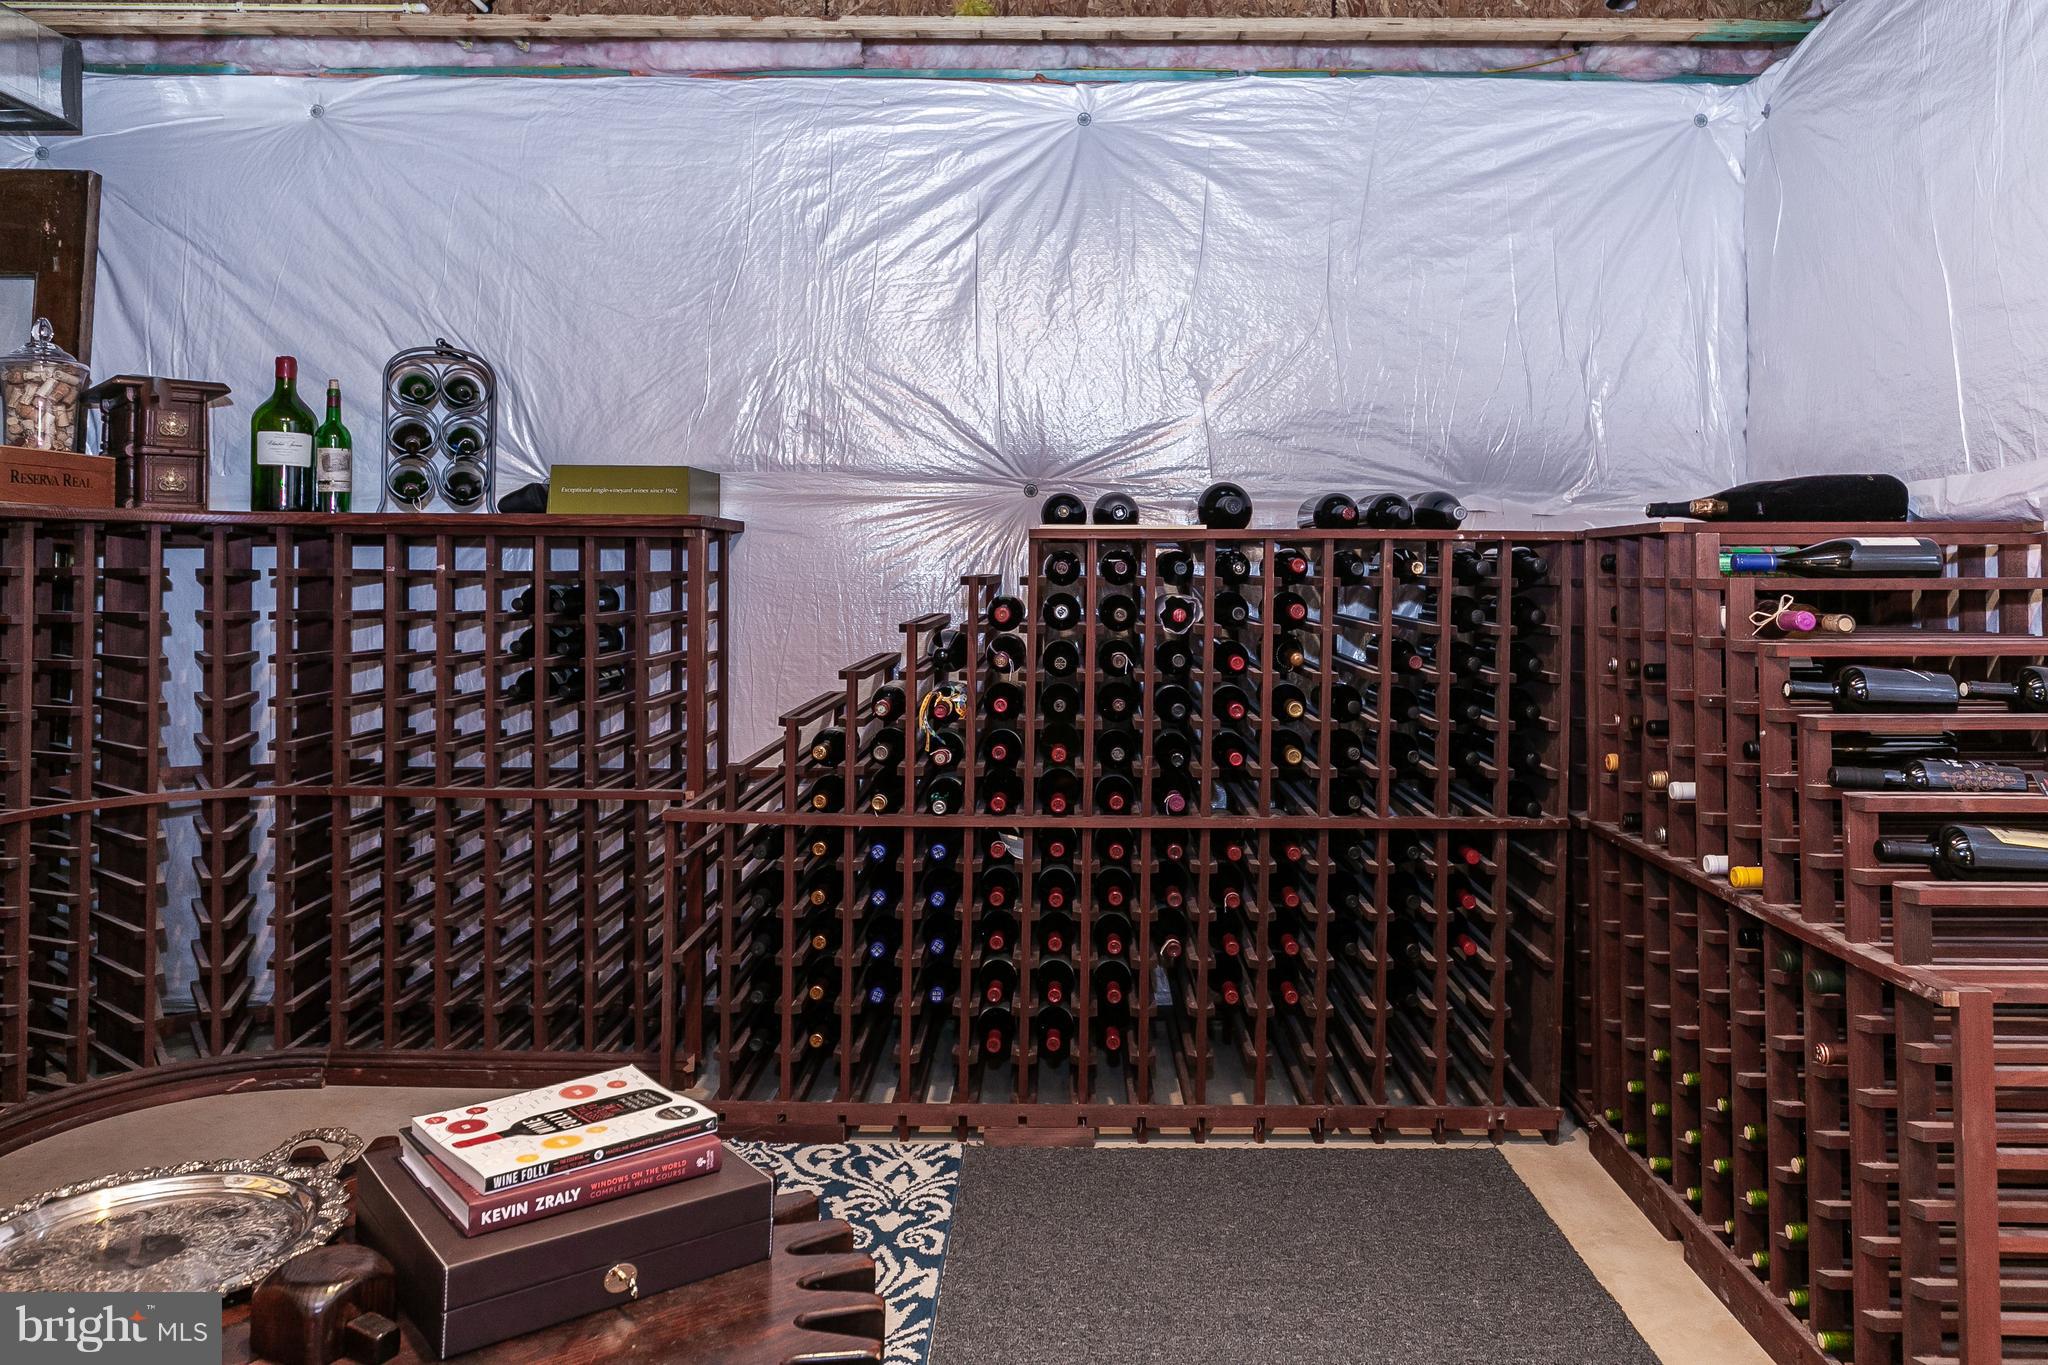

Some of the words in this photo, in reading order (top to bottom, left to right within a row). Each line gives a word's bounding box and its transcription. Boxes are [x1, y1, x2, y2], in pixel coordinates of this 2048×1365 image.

[561, 486, 592, 495] Exceptional
[593, 487, 632, 495] single-vineyard
[493, 1173, 519, 1188] WINE
[521, 1163, 550, 1182] FOLLY
[590, 1182, 631, 1198] COMPLETE
[634, 1176, 653, 1187] WINE
[656, 1168, 686, 1180] COURSE
[591, 1175, 629, 1190] WINDOWS
[646, 1167, 659, 1175] THE
[662, 1159, 687, 1171] WORLD
[481, 1200, 529, 1226] KEVIN
[535, 1187, 582, 1212] ZRALY
